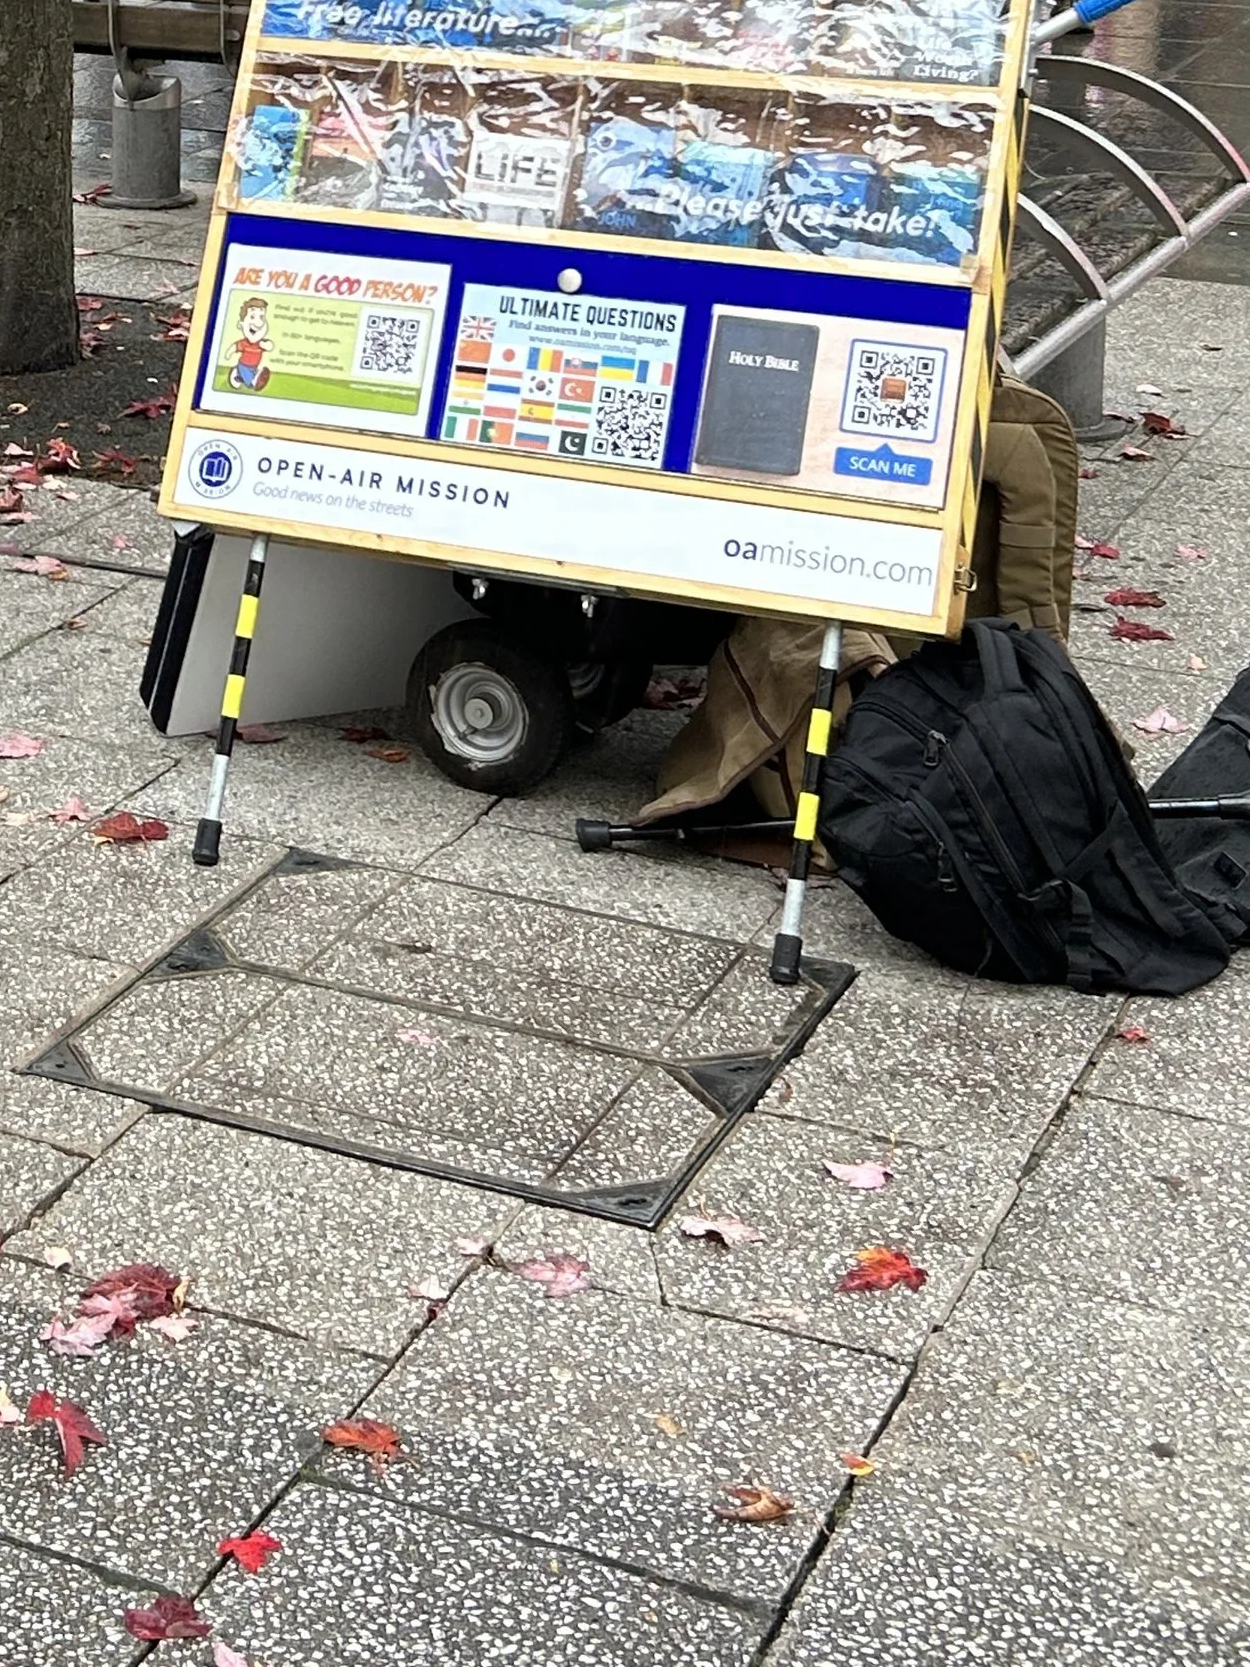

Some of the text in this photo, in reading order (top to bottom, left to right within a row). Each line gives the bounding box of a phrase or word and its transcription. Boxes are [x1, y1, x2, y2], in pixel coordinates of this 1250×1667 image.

[913, 64, 979, 83] Living?
[476, 151, 559, 187] LIFE
[598, 208, 638, 228] JOHN
[763, 183, 838, 233] just
[851, 204, 936, 238] take!
[233, 267, 438, 305] ARE YOU A GOOD PERSON?
[499, 295, 678, 333] ULTIMATE QUESTIONS
[509, 319, 532, 331] Find
[534, 322, 578, 337] answers
[580, 325, 591, 338] in
[593, 329, 617, 344] your
[257, 457, 511, 509] OPEN-AIR MISSION
[849, 456, 917, 478] SCAN ME
[253, 481, 414, 519] Good news on the streets
[723, 538, 933, 587] oamission.com
